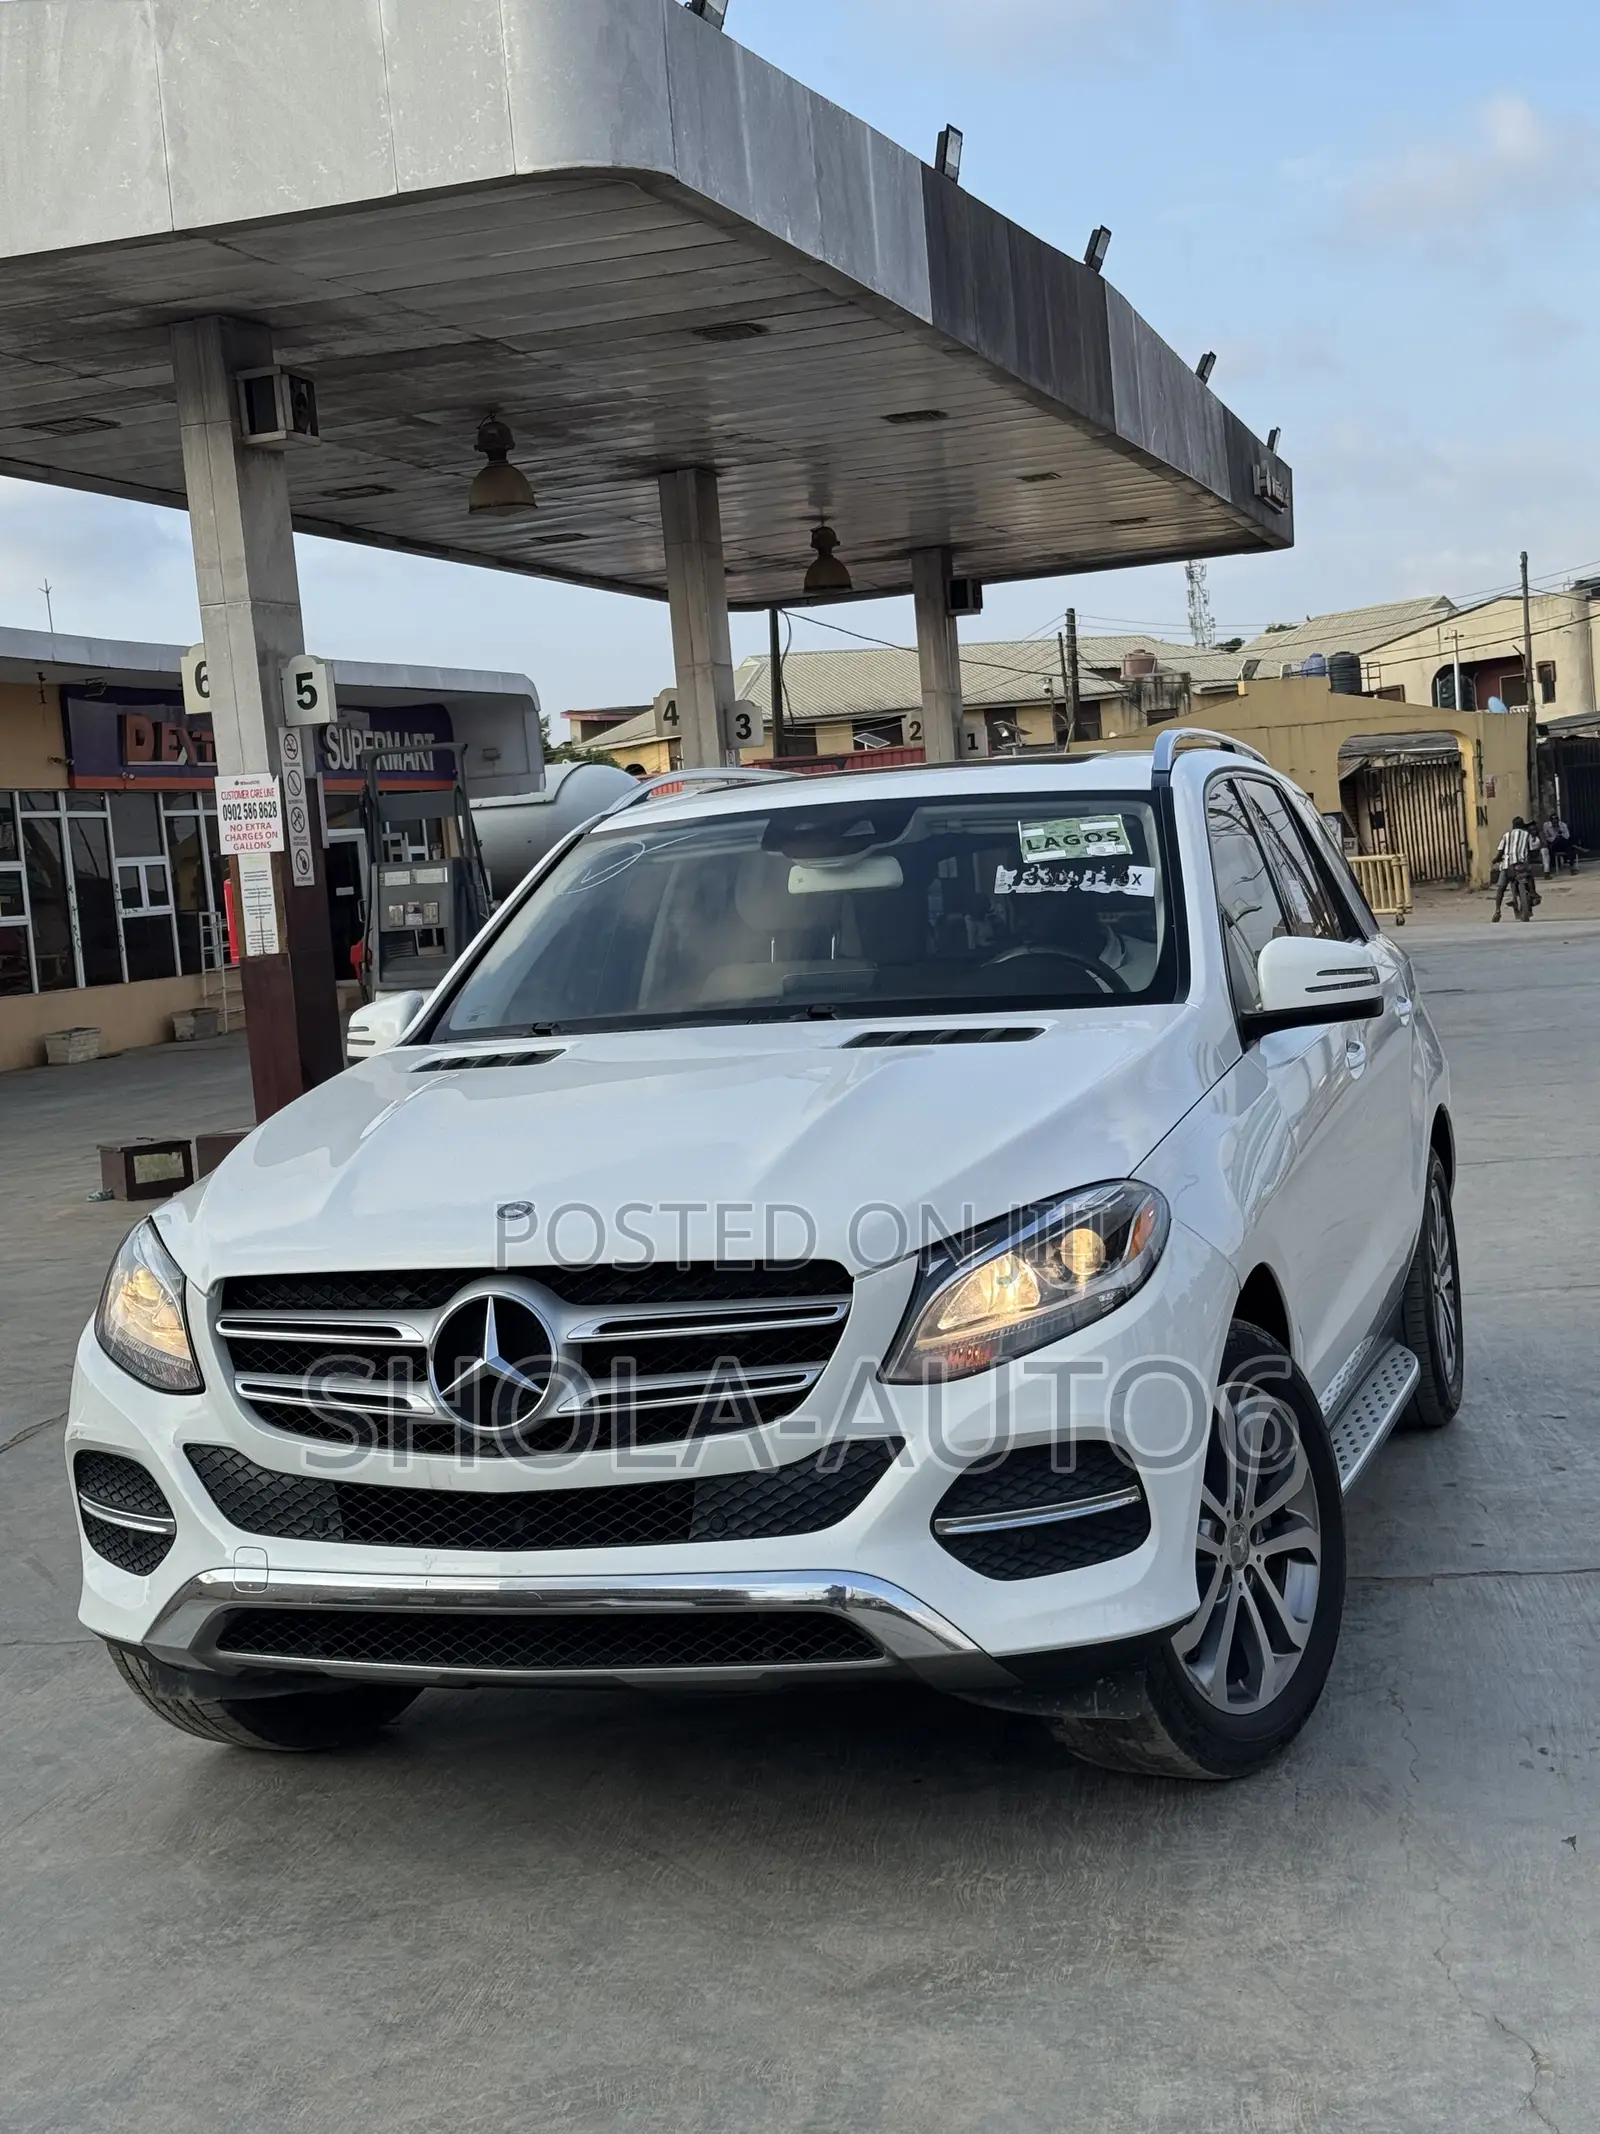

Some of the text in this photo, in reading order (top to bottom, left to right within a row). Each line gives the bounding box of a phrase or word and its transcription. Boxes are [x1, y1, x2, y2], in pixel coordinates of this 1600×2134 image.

[194, 661, 210, 698] 6
[295, 672, 318, 710] 5
[663, 700, 680, 727] 4
[735, 713, 752, 740] 3
[909, 721, 923, 741] 2
[967, 732, 979, 750] 1
[221, 787, 276, 801] CUSTOMER CARE LINE
[222, 801, 278, 821] 0902 586 8628
[224, 831, 278, 842] CHARGES ON
[230, 822, 272, 832] NO EXTRA
[233, 841, 272, 851] GALLONS
[1026, 830, 1121, 851] LAGOS
